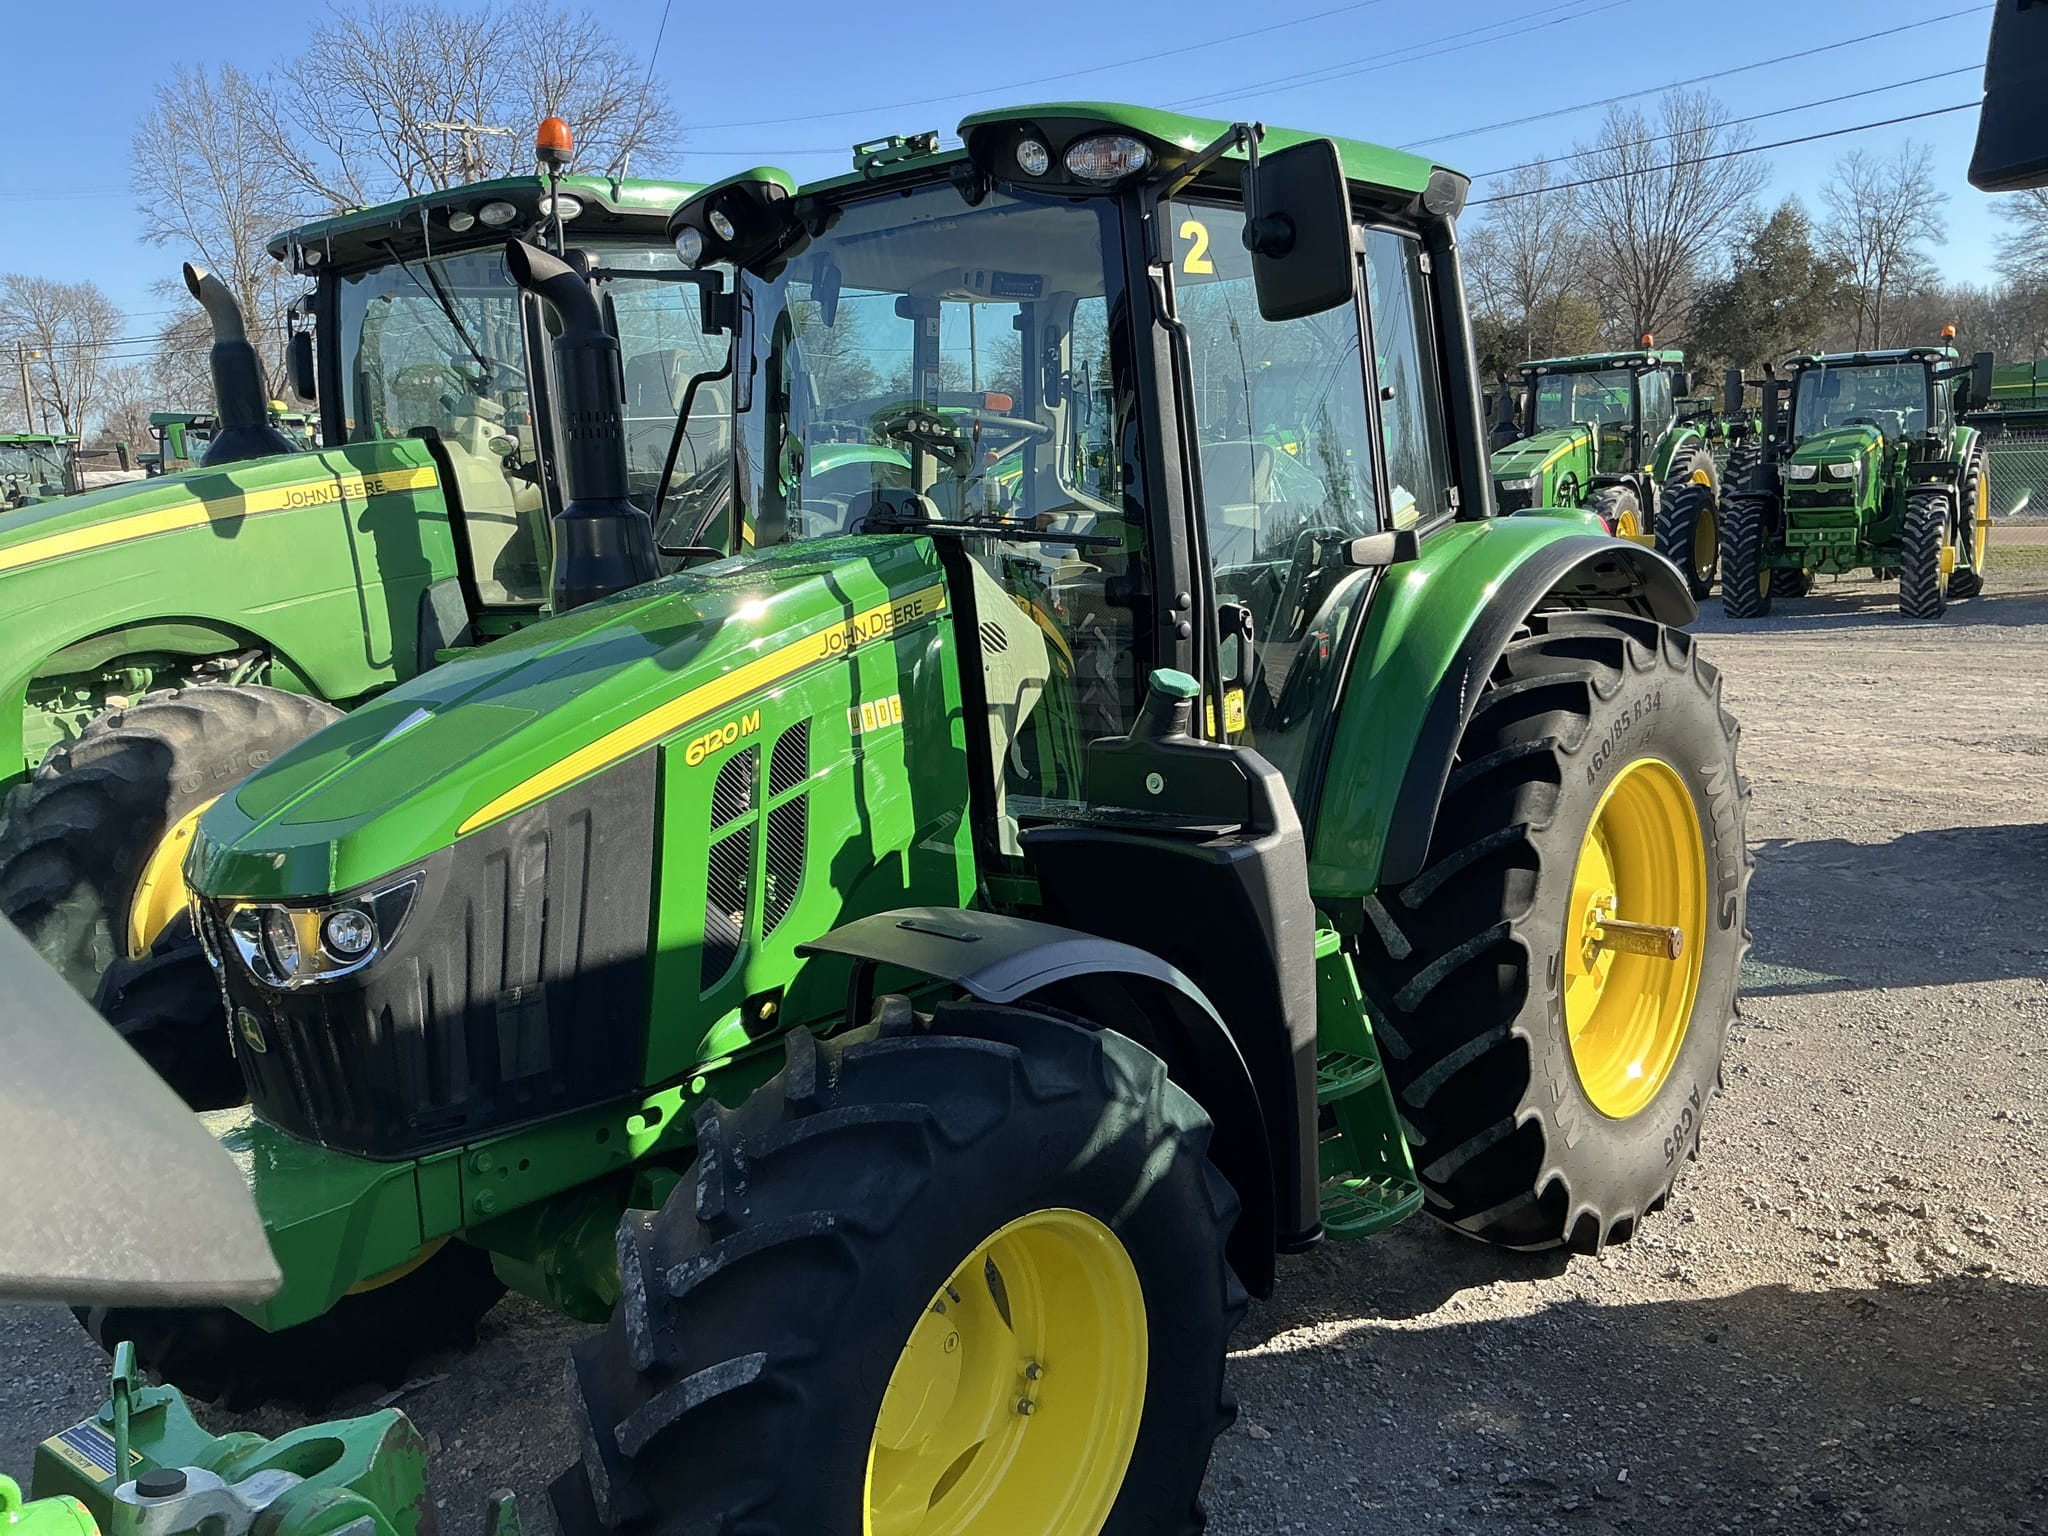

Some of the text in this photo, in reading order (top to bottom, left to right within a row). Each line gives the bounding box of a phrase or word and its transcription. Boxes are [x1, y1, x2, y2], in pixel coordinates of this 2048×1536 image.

[1179, 220, 1214, 275] 2
[282, 480, 385, 507] JOHN DEERE
[820, 599, 924, 657] JOHN DEERE
[1586, 710, 1631, 786] 460/85
[1644, 690, 1662, 715] 34
[1663, 1082, 1701, 1169] AC85
